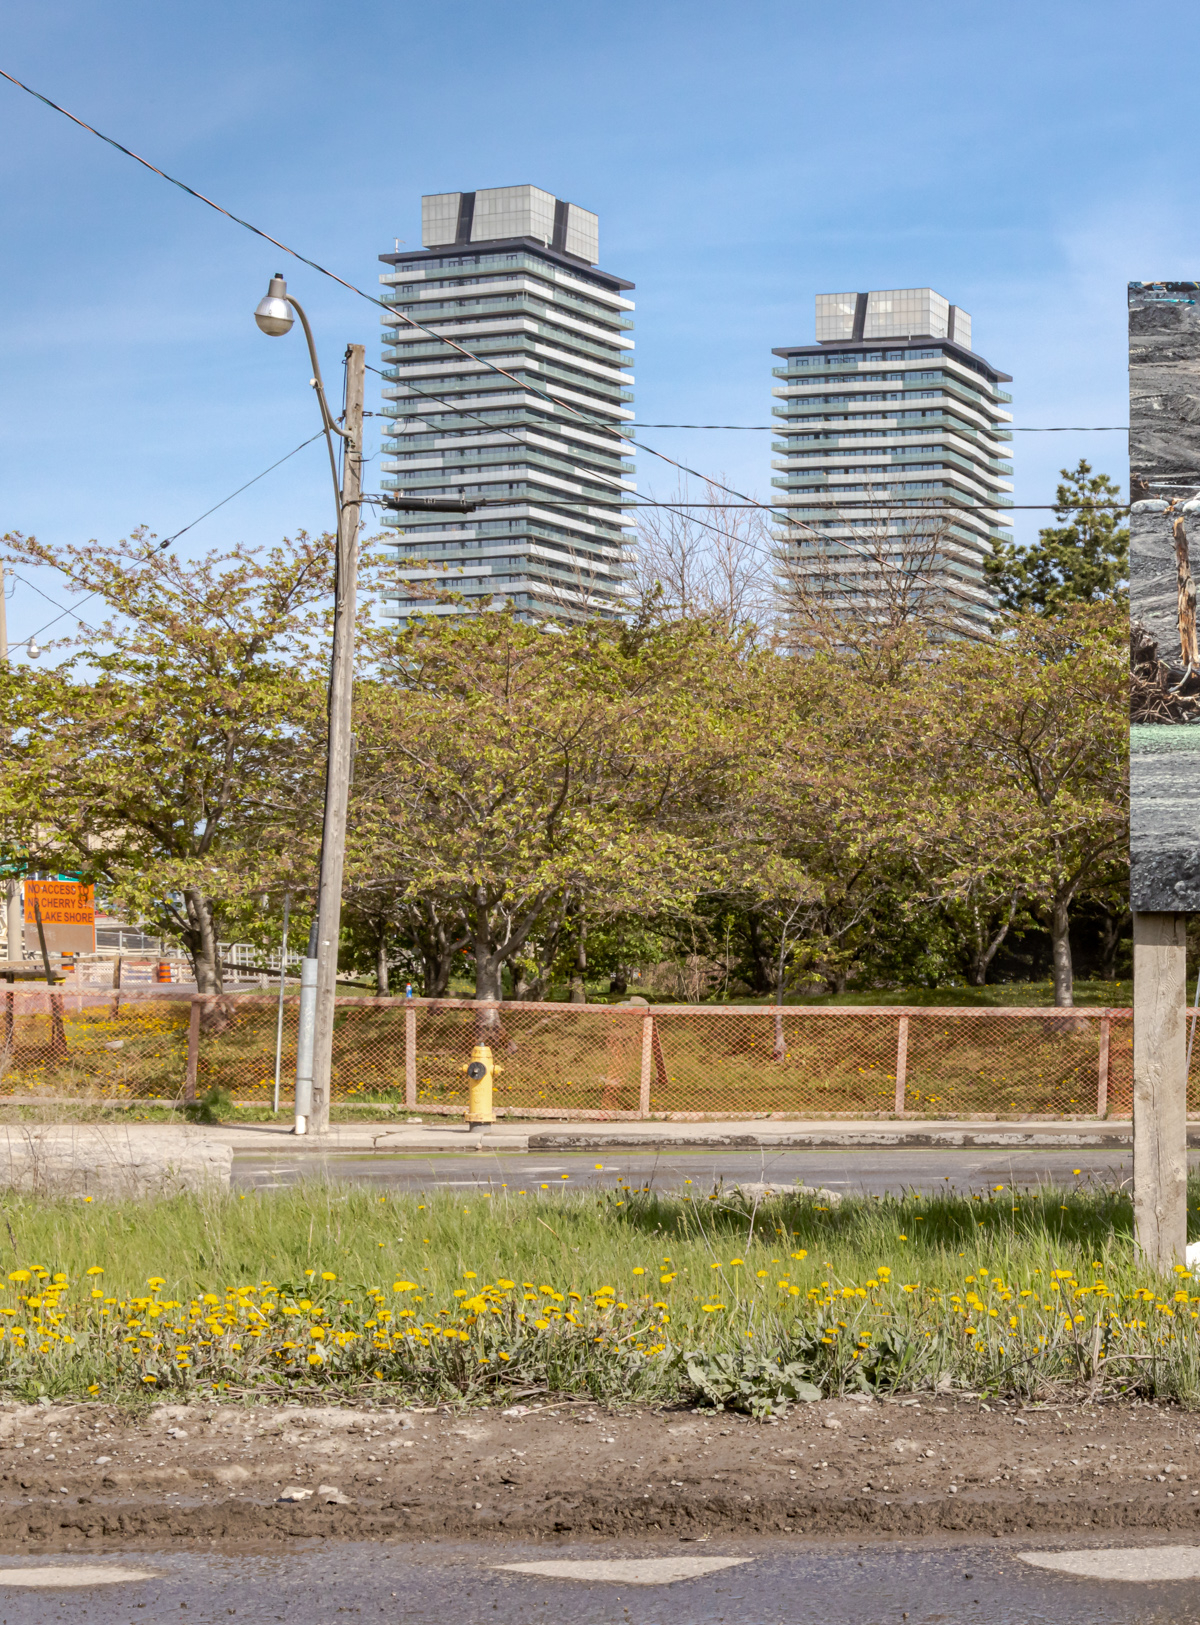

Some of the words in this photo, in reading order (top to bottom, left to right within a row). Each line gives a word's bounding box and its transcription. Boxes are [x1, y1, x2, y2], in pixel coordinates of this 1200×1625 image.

[28, 883, 40, 894] NO
[42, 884, 76, 895] ACCESS
[78, 885, 89, 896] TO
[41, 897, 76, 908] CHERRY
[64, 912, 93, 923] SHORE
